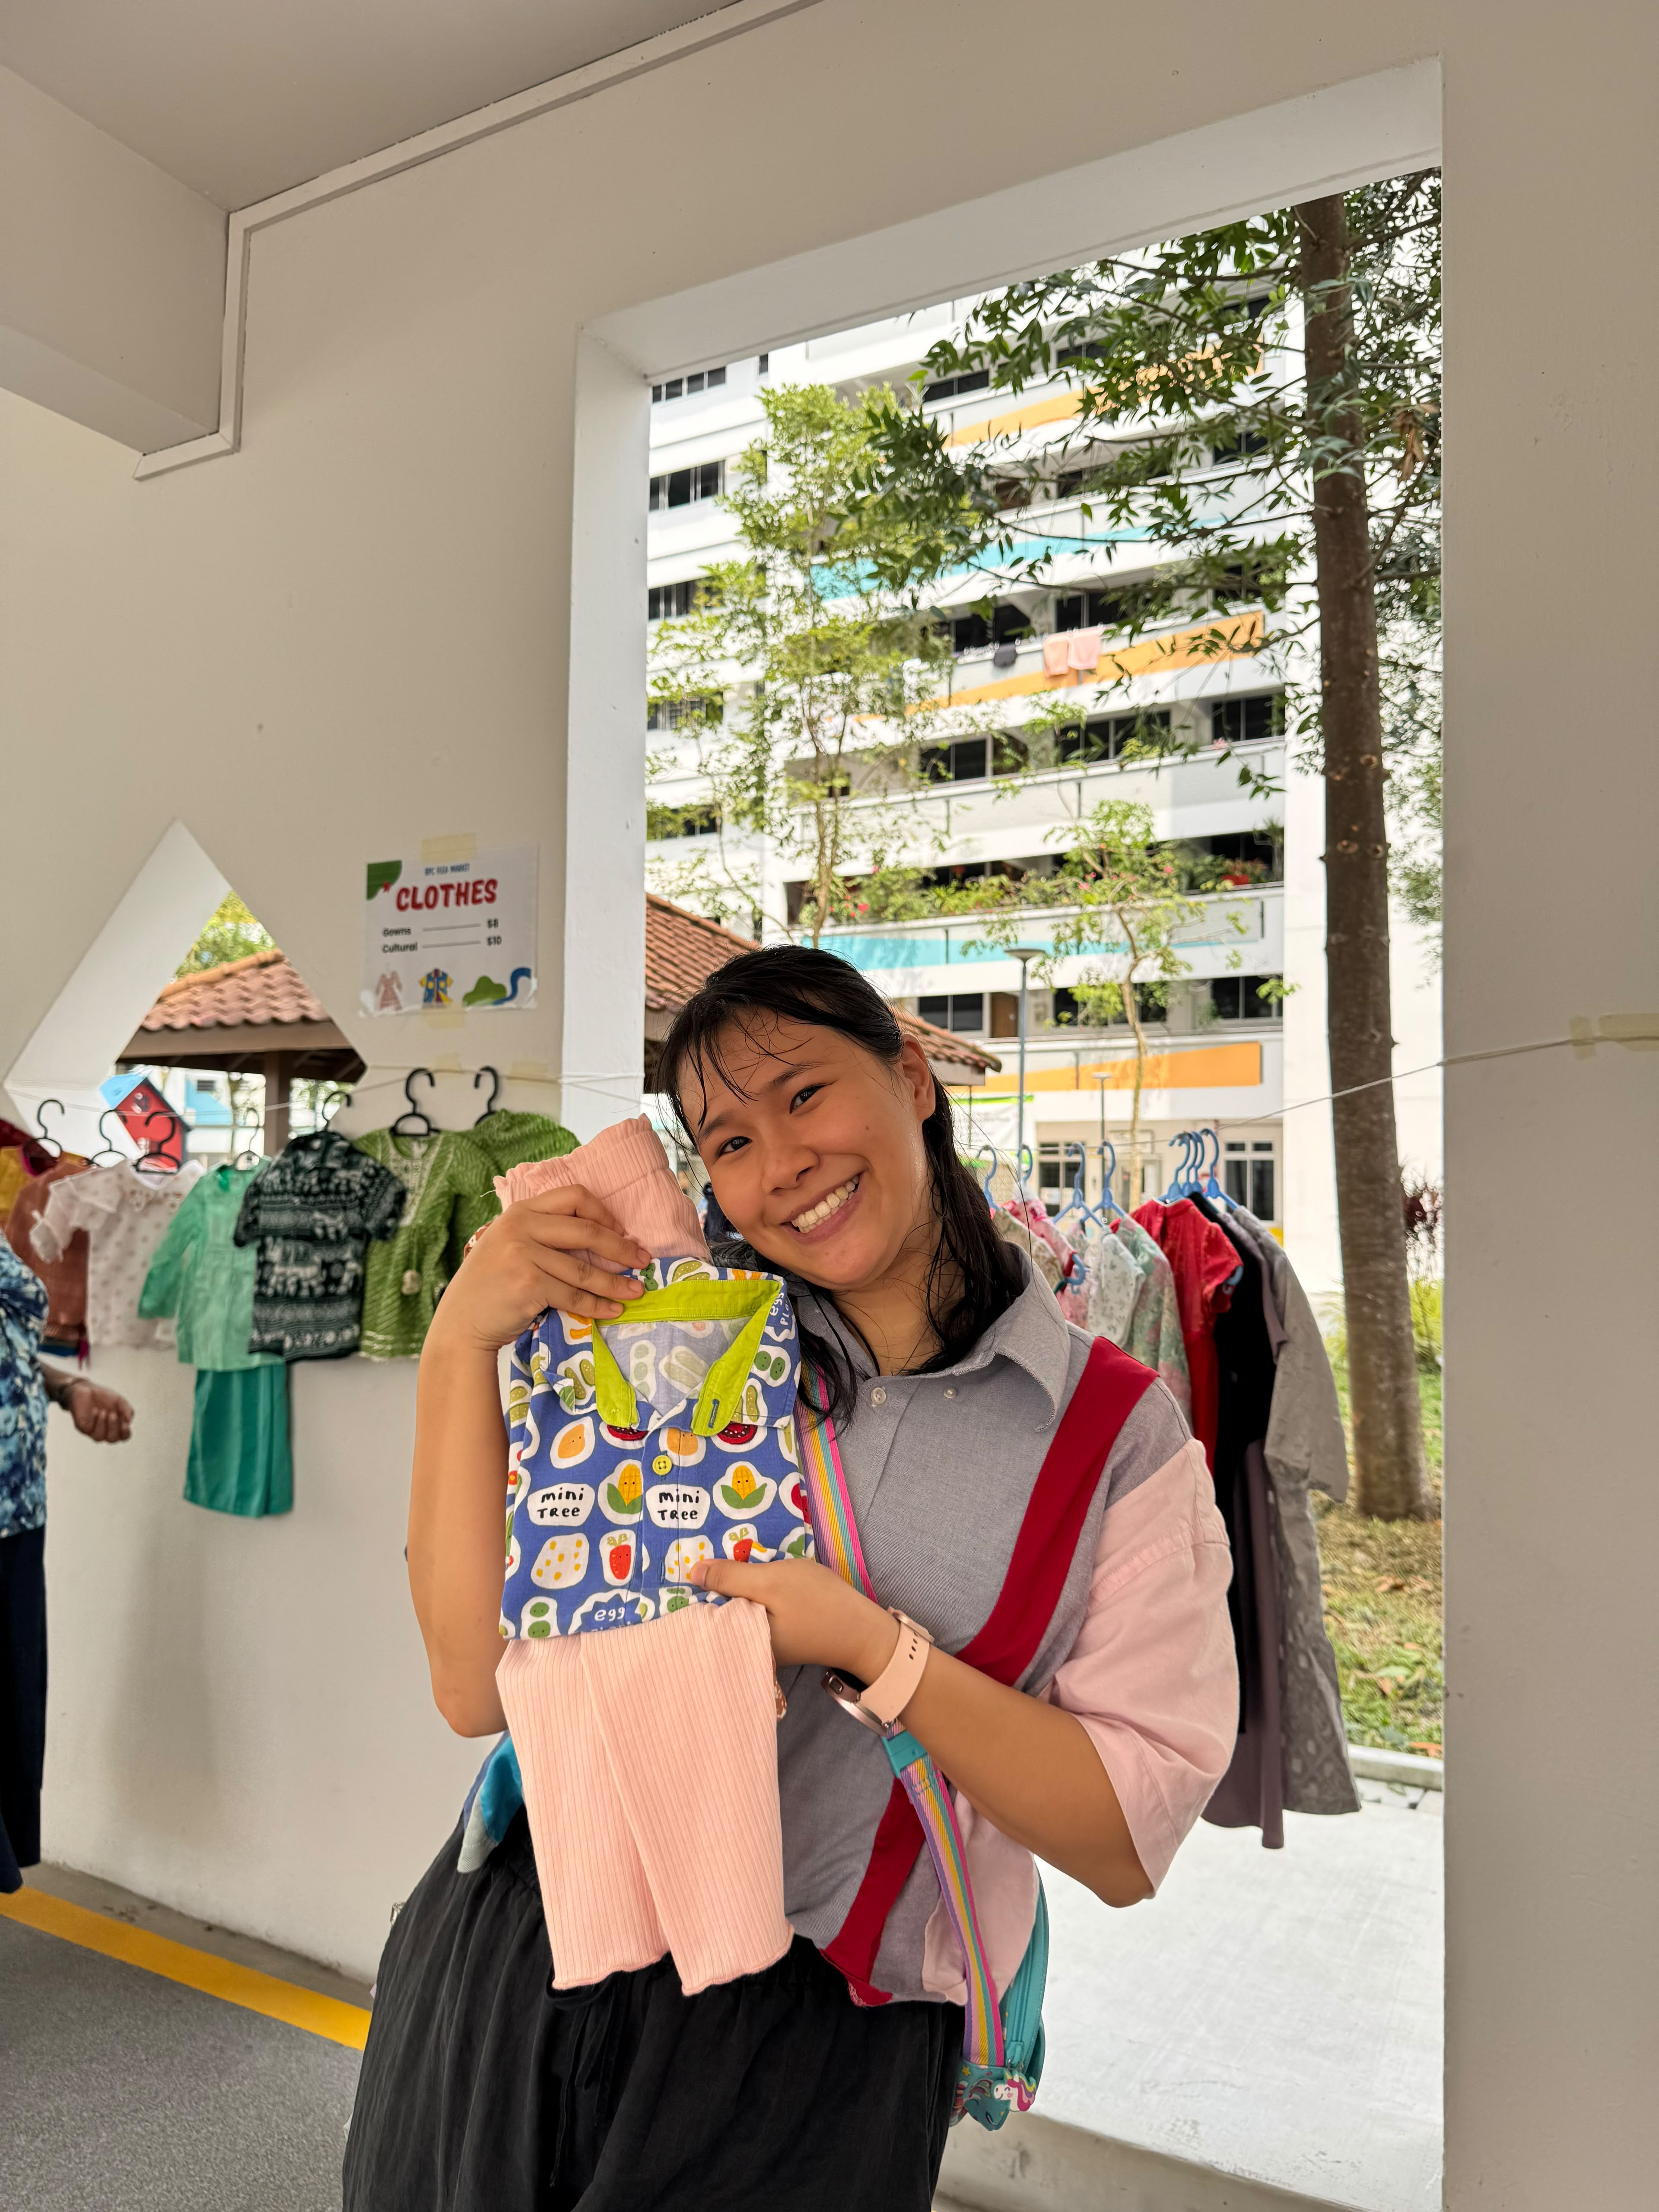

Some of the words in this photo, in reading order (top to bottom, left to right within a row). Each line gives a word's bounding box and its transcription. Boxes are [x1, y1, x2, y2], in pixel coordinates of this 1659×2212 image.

[396, 878, 498, 912] CLOTHES
[382, 927, 412, 937] Gowns
[487, 918, 499, 928] $8
[382, 942, 418, 953] Cultural
[487, 935, 502, 946] $10
[541, 1487, 584, 1503] mini
[659, 1488, 699, 1503] mini
[594, 1607, 625, 1621] egg
